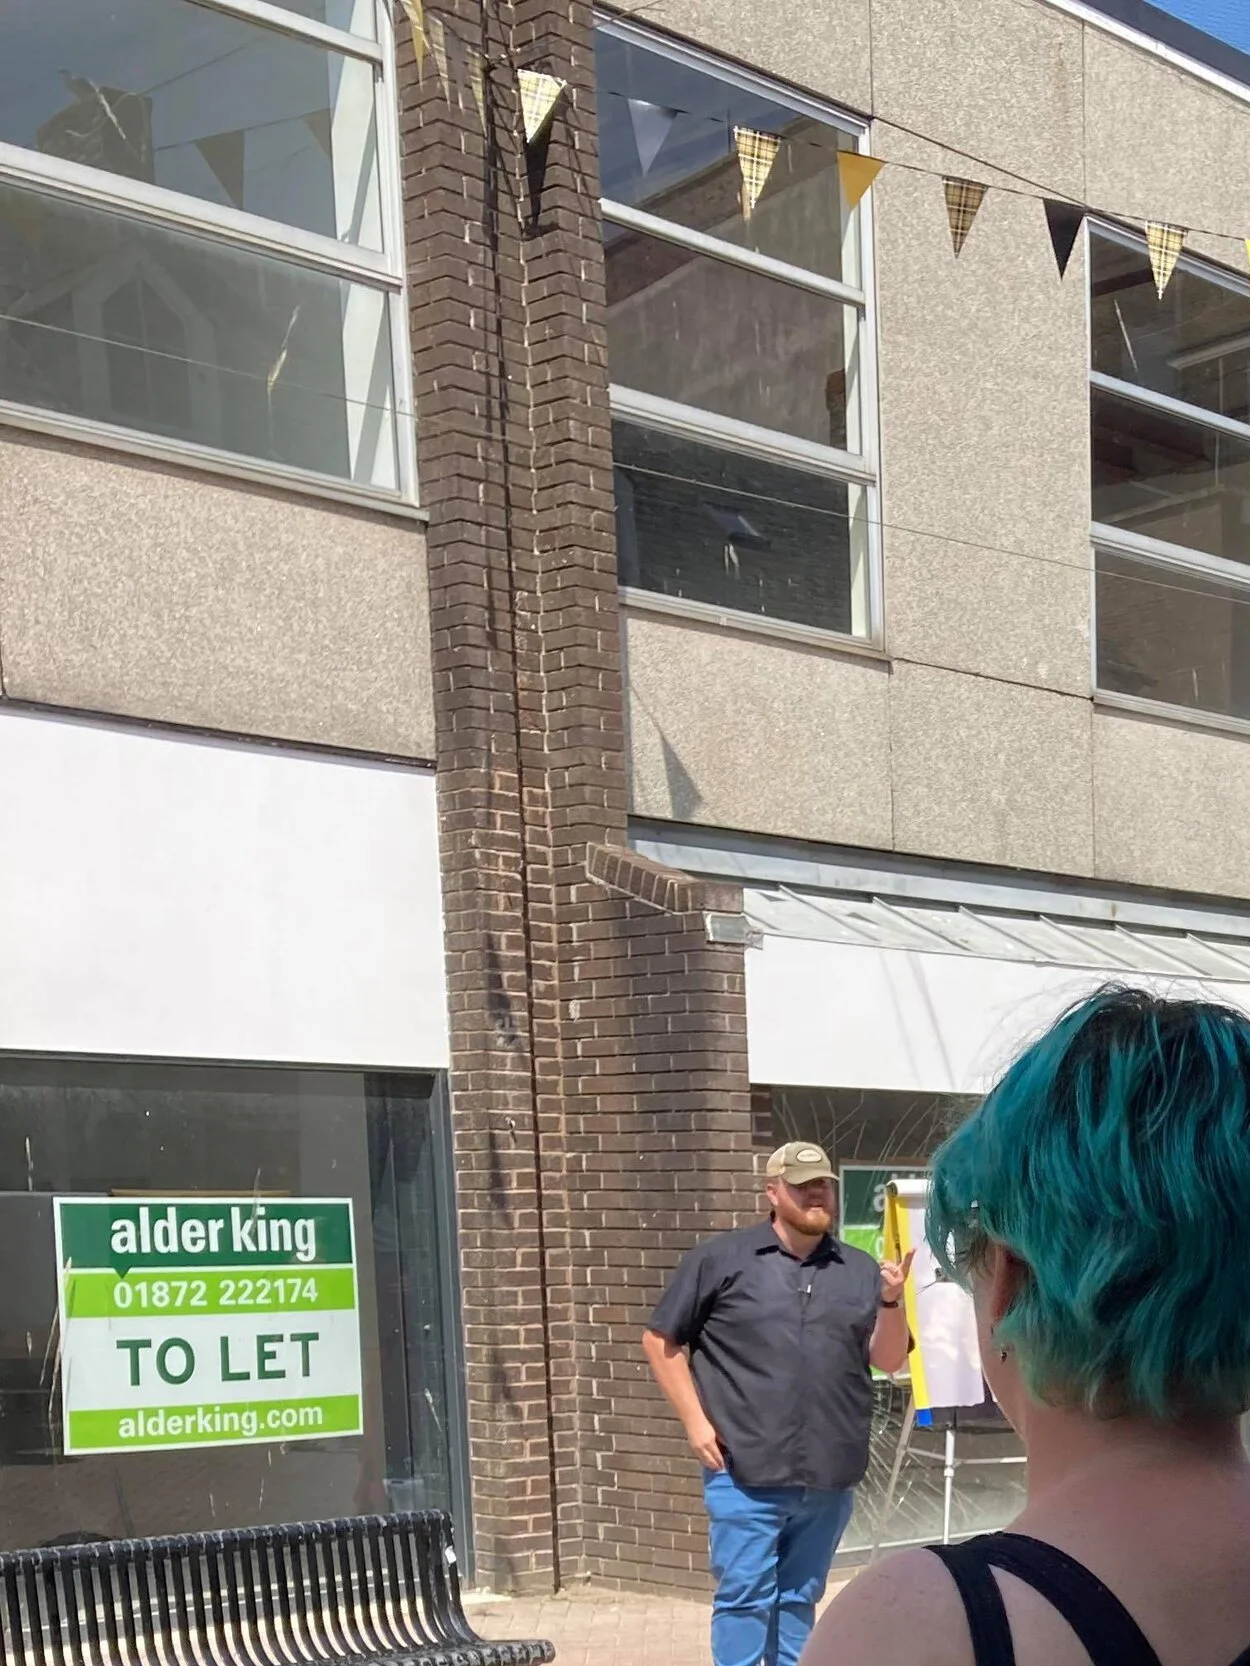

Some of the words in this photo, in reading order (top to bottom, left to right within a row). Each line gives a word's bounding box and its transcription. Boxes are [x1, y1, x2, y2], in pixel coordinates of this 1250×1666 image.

[110, 1206, 224, 1254] alder
[231, 1206, 316, 1262] king
[113, 1280, 207, 1309] 01872
[219, 1277, 319, 1305] 222174
[116, 1336, 196, 1387] TO
[219, 1331, 320, 1383] LET
[118, 1404, 323, 1438] alderking.com
